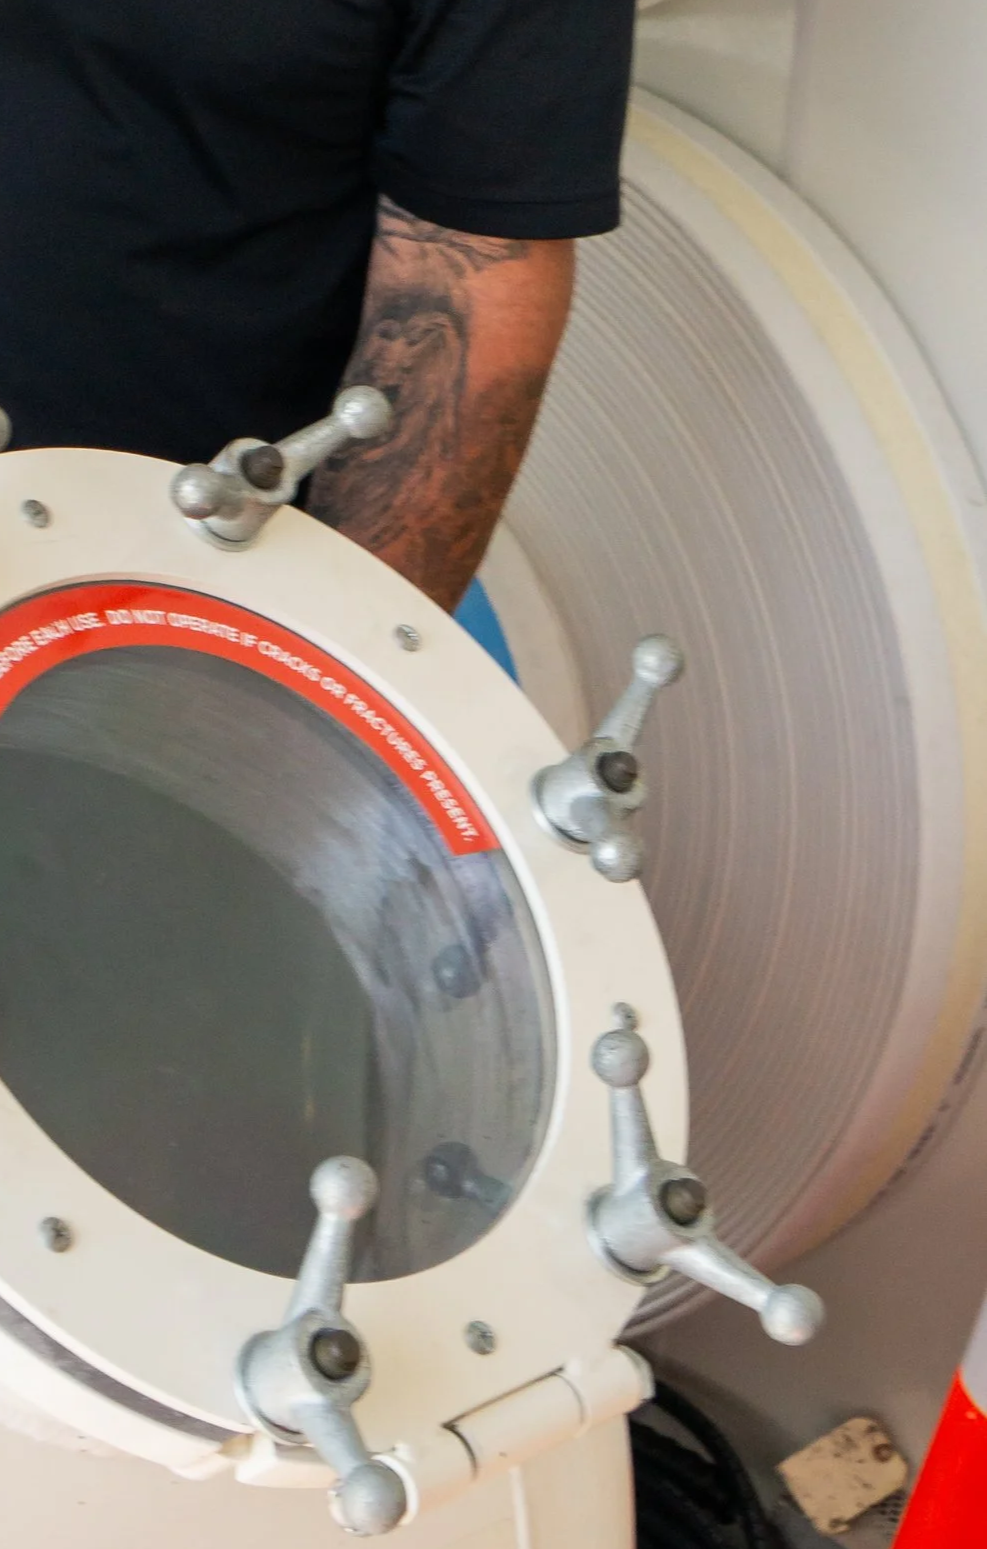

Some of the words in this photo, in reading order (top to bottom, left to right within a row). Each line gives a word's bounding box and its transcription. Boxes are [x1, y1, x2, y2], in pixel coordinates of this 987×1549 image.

[104, 608, 132, 626] DO
[130, 609, 167, 626] NOT
[166, 612, 241, 644] OPERATE
[239, 631, 259, 648] IF
[257, 640, 323, 683] CRACKS
[320, 676, 347, 700] OR
[343, 693, 428, 771] FRACTURES
